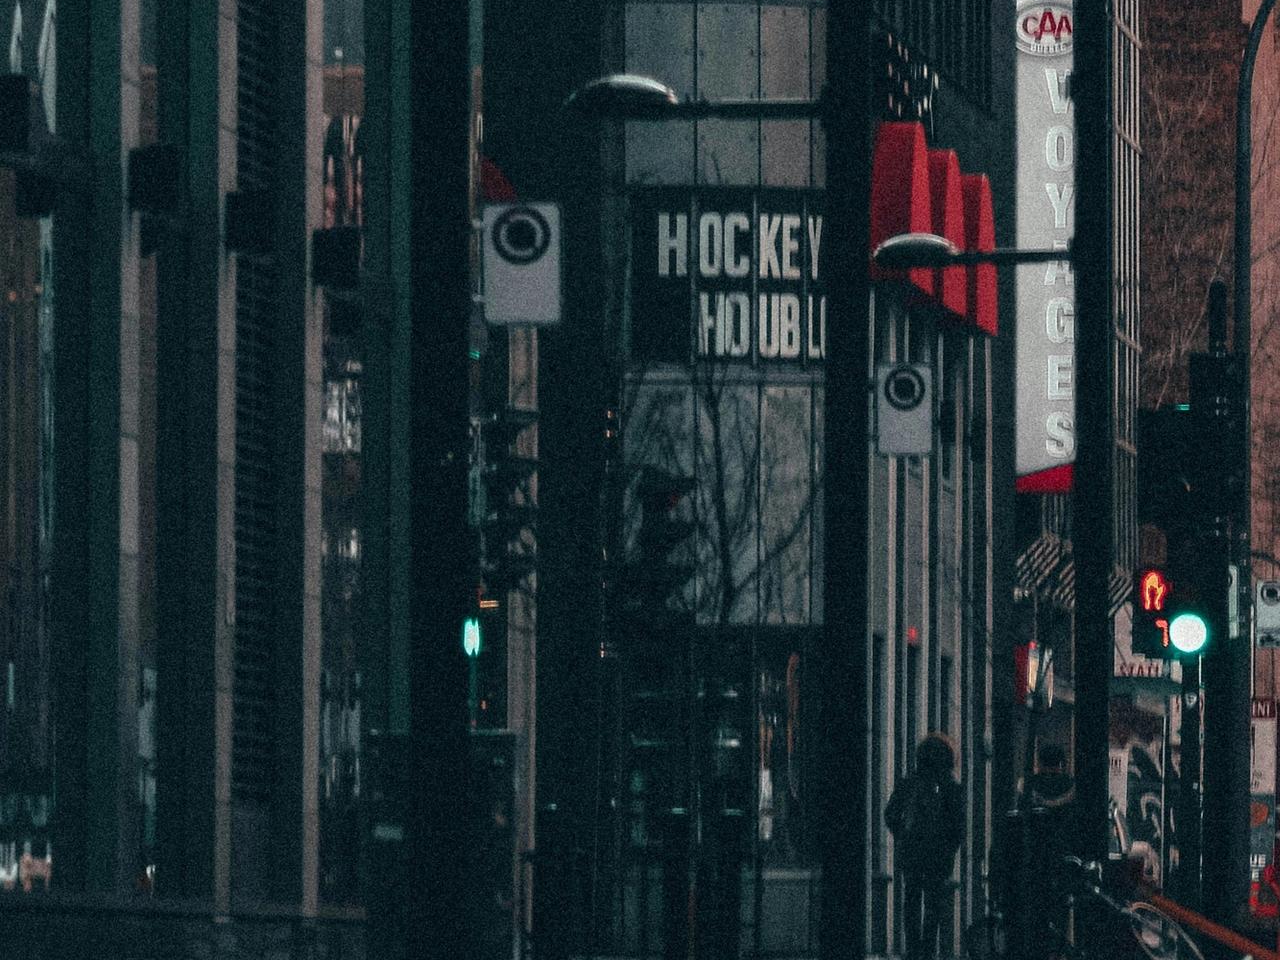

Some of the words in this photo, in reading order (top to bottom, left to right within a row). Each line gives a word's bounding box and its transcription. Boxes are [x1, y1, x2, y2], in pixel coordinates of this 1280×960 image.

[1022, 8, 1073, 42] CAA
[658, 211, 823, 280] HOCKEY
[1044, 68, 1074, 458] VOYAGES
